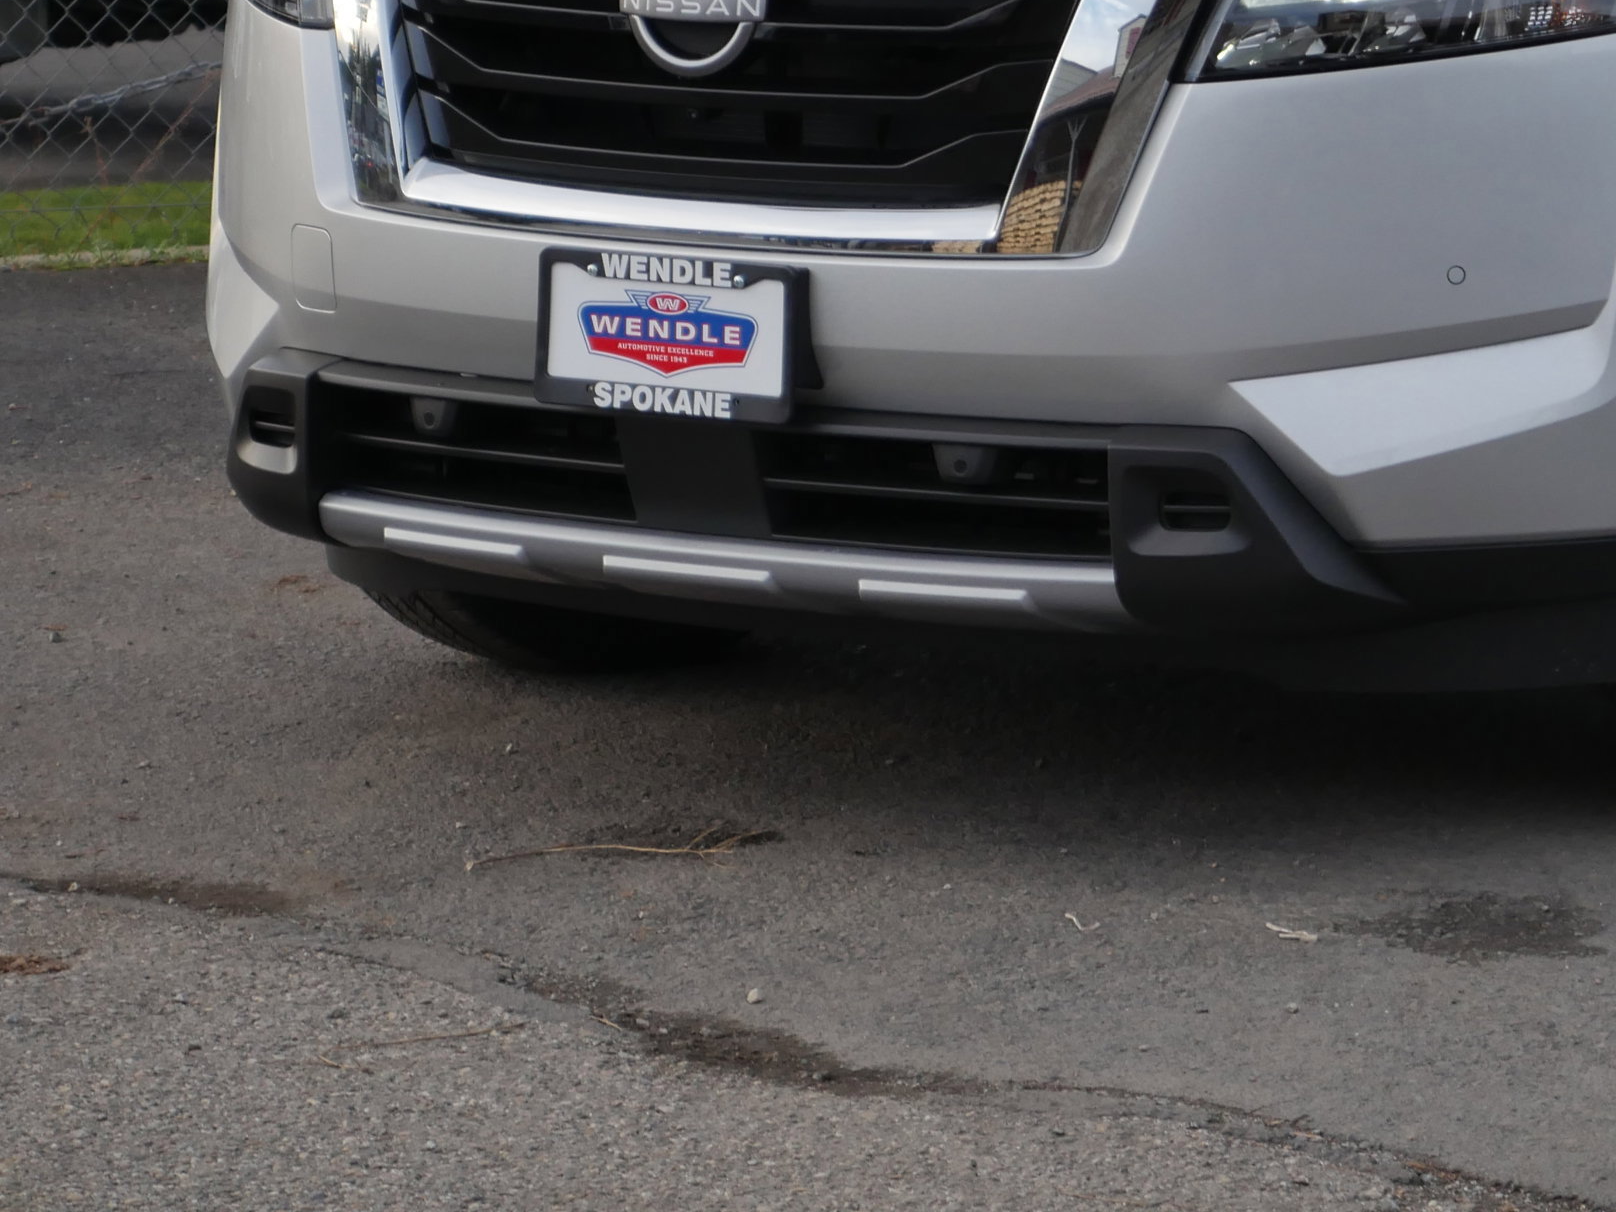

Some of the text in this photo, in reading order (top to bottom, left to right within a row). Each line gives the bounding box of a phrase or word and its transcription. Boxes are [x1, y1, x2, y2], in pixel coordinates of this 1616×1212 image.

[601, 252, 732, 287] WENDLE
[590, 313, 741, 346] WENDLE
[617, 342, 714, 358] AUTOMOTIVE EXCELLENCE
[645, 352, 688, 365] SINCE 1943
[592, 381, 732, 420] SPOKANE
